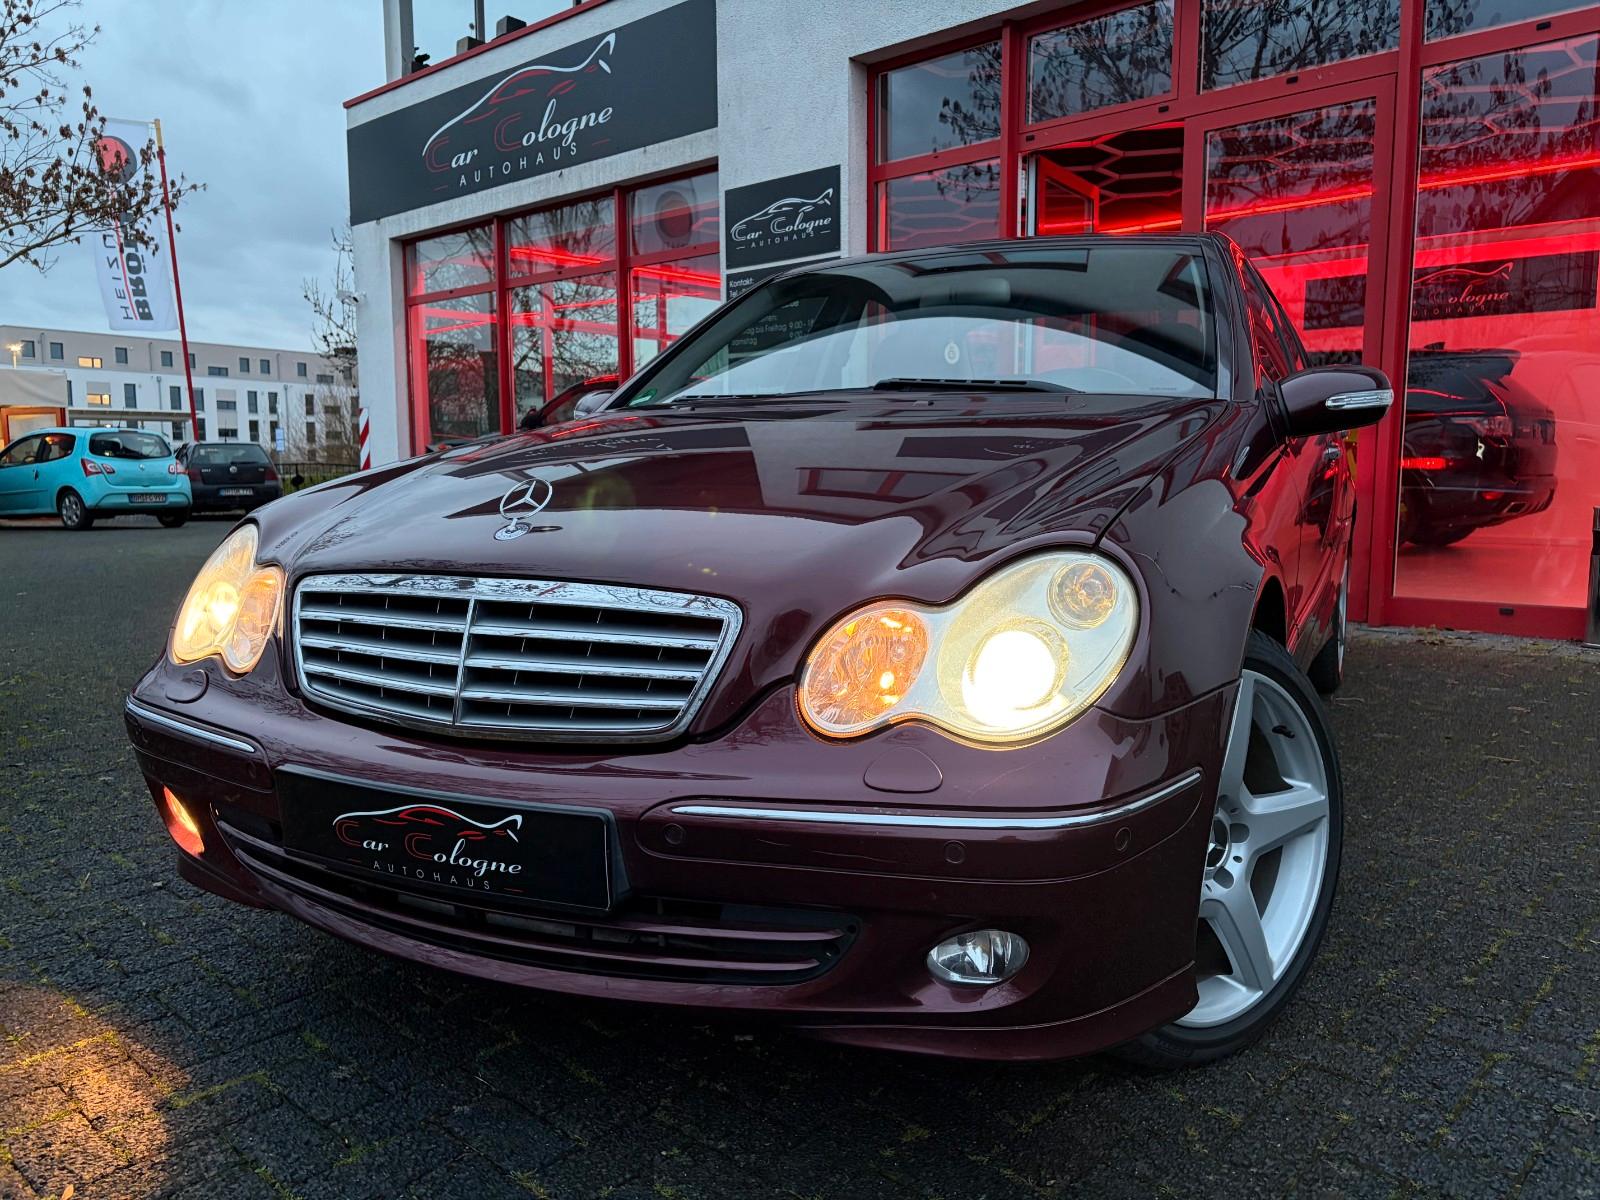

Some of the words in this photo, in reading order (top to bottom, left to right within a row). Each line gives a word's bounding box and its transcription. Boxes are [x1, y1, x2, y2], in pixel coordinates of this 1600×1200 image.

[425, 136, 478, 173] Car
[494, 98, 613, 152] Cologne
[459, 142, 578, 188] AUTOHAUS
[731, 224, 763, 242] Car
[770, 212, 832, 234] Cologne
[750, 231, 815, 249] AUTOHAUS
[335, 819, 390, 852] Car
[404, 832, 523, 877] Cologne
[372, 860, 491, 890] AUTOHAUS
